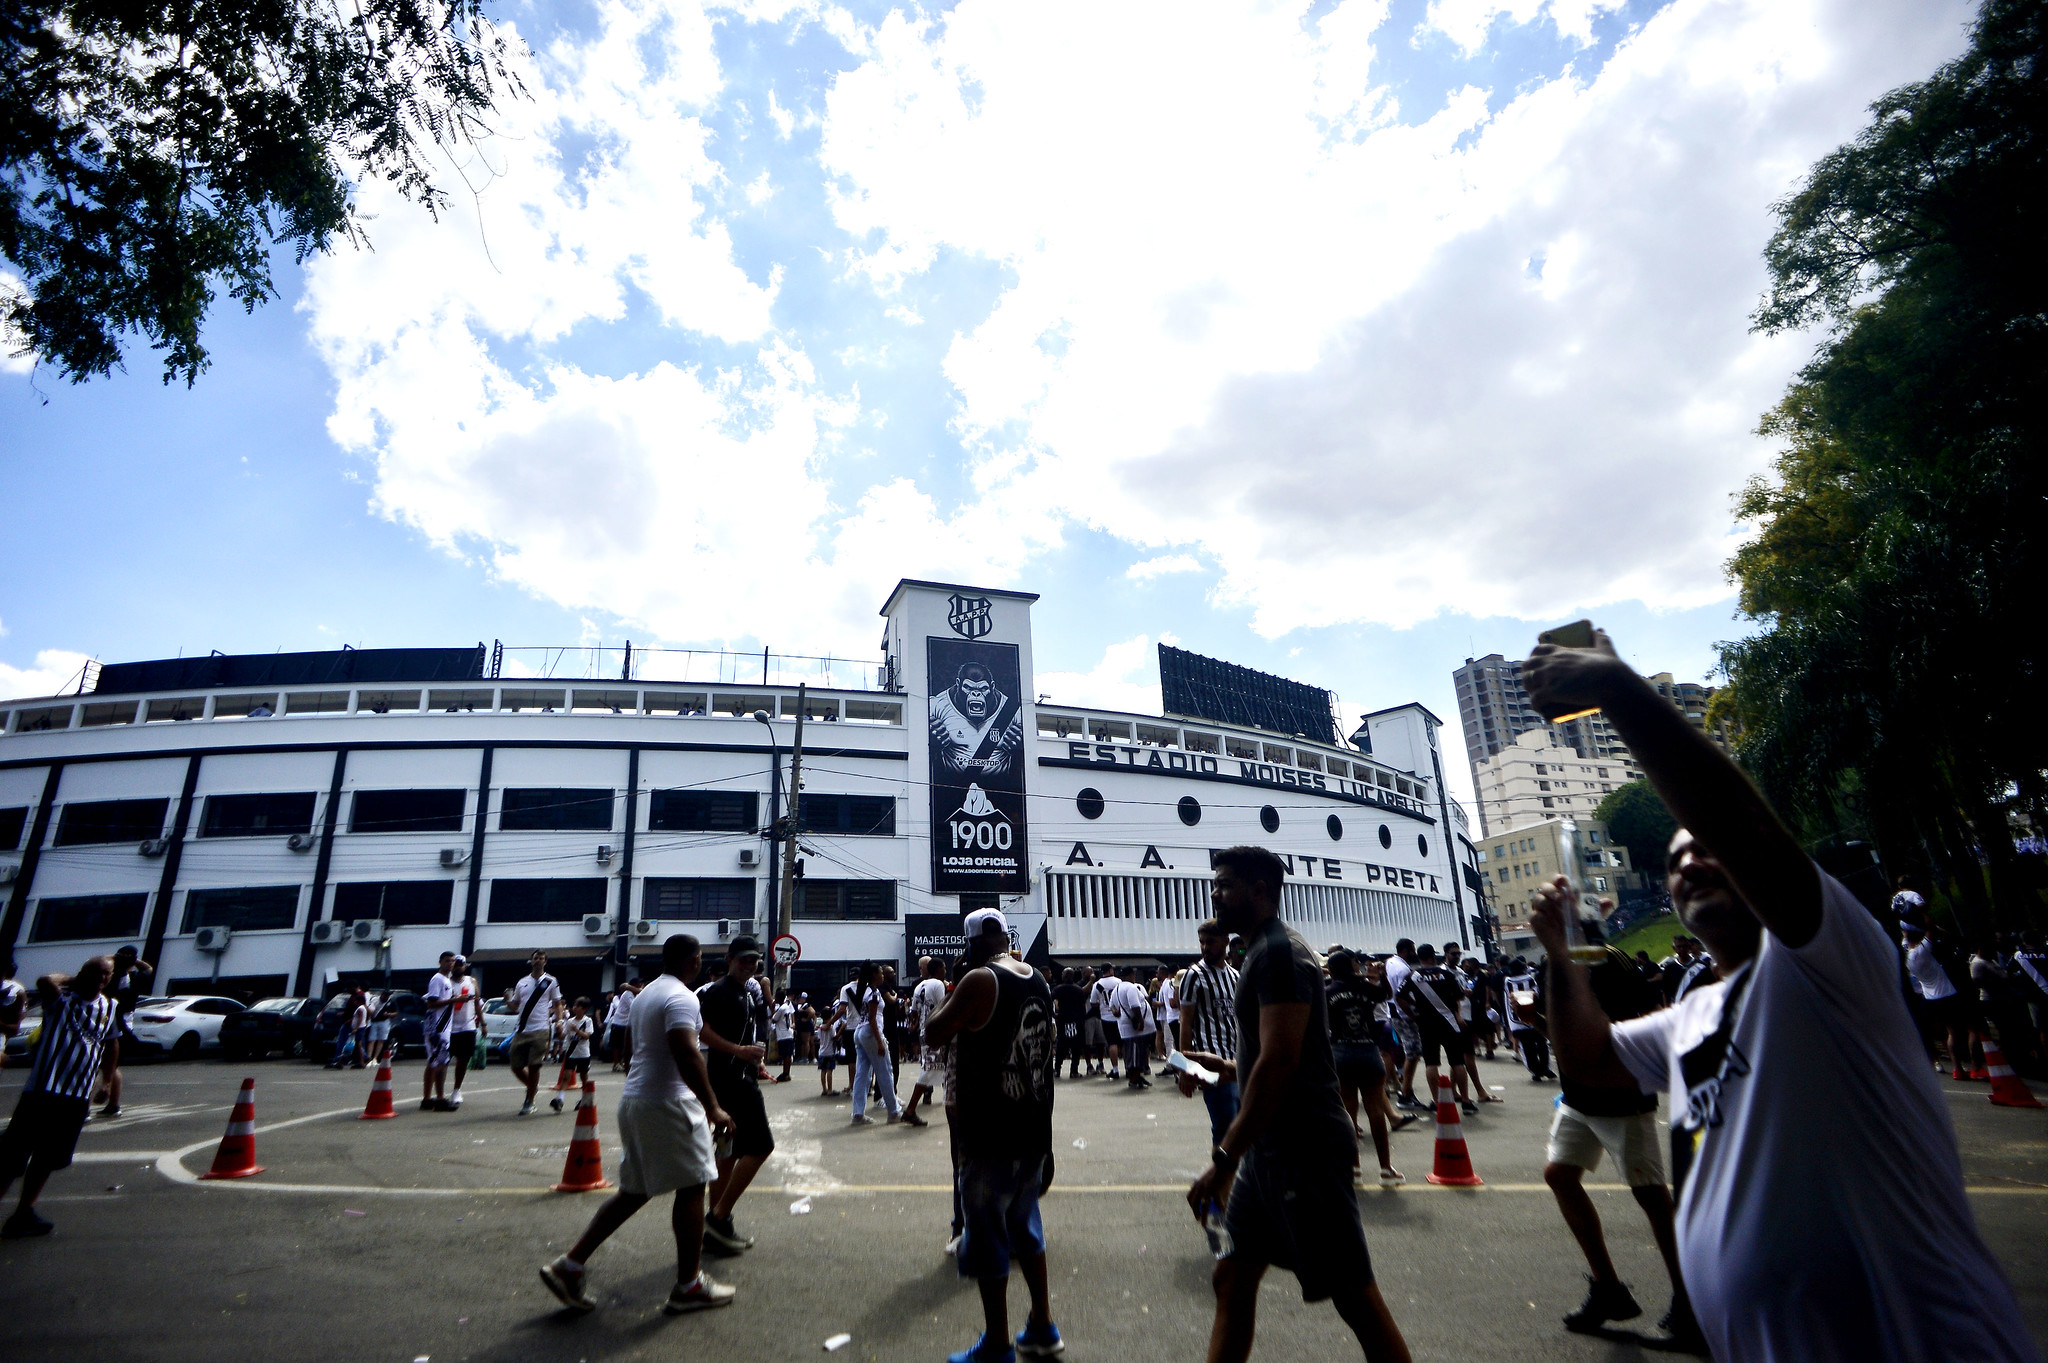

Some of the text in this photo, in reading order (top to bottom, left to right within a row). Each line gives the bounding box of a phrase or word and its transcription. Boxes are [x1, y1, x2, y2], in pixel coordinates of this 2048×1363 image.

[1069, 742, 1425, 816] ESTADIO MOISES LUCARELLI
[950, 820, 1012, 850] 1900
[943, 857, 1018, 867] LOJA OFICIAL
[1065, 841, 1104, 868] A.
[1140, 844, 1175, 870] A.
[1365, 862, 1440, 895] PRETA
[914, 947, 920, 955] é
